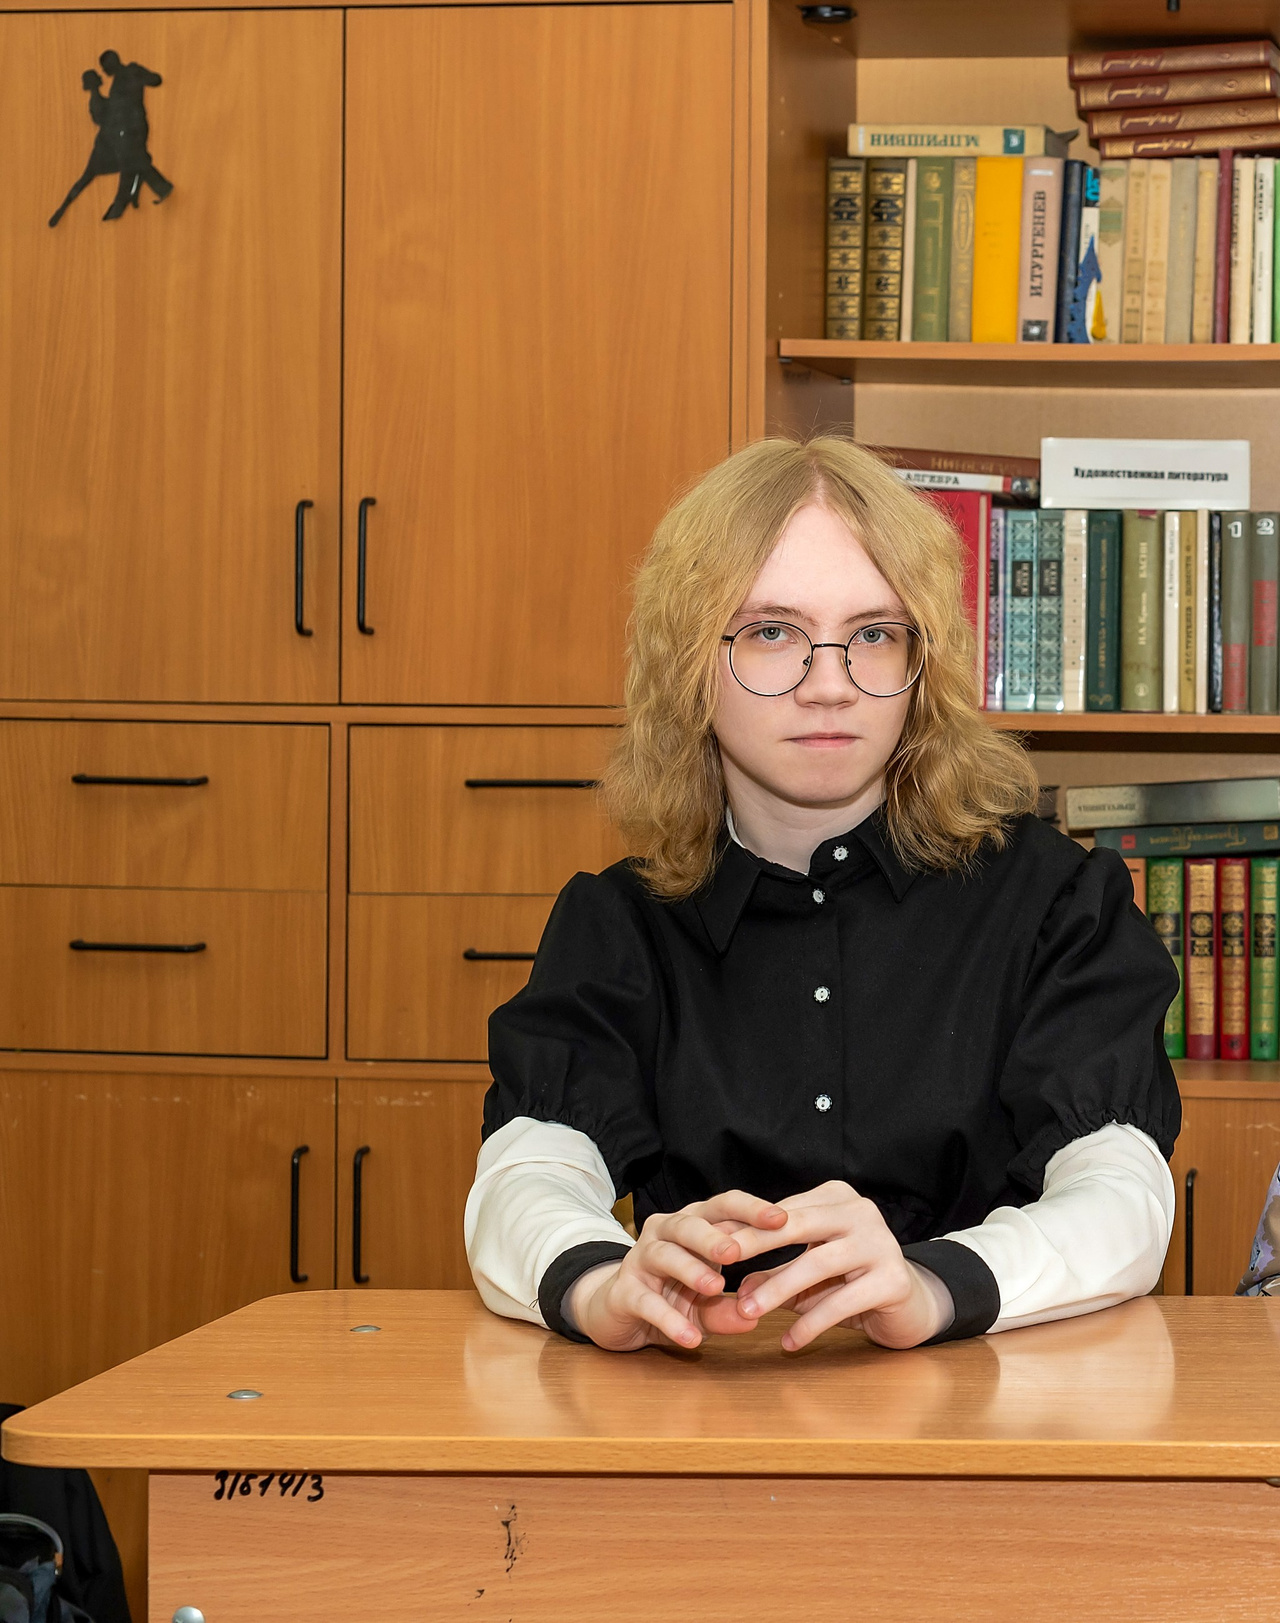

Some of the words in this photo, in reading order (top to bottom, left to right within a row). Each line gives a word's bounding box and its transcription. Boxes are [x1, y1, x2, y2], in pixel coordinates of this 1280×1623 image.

[1073, 467, 1165, 481] Художественная
[1166, 470, 1229, 482] литература
[1227, 521, 1243, 539] 1
[1256, 517, 1275, 536] 2
